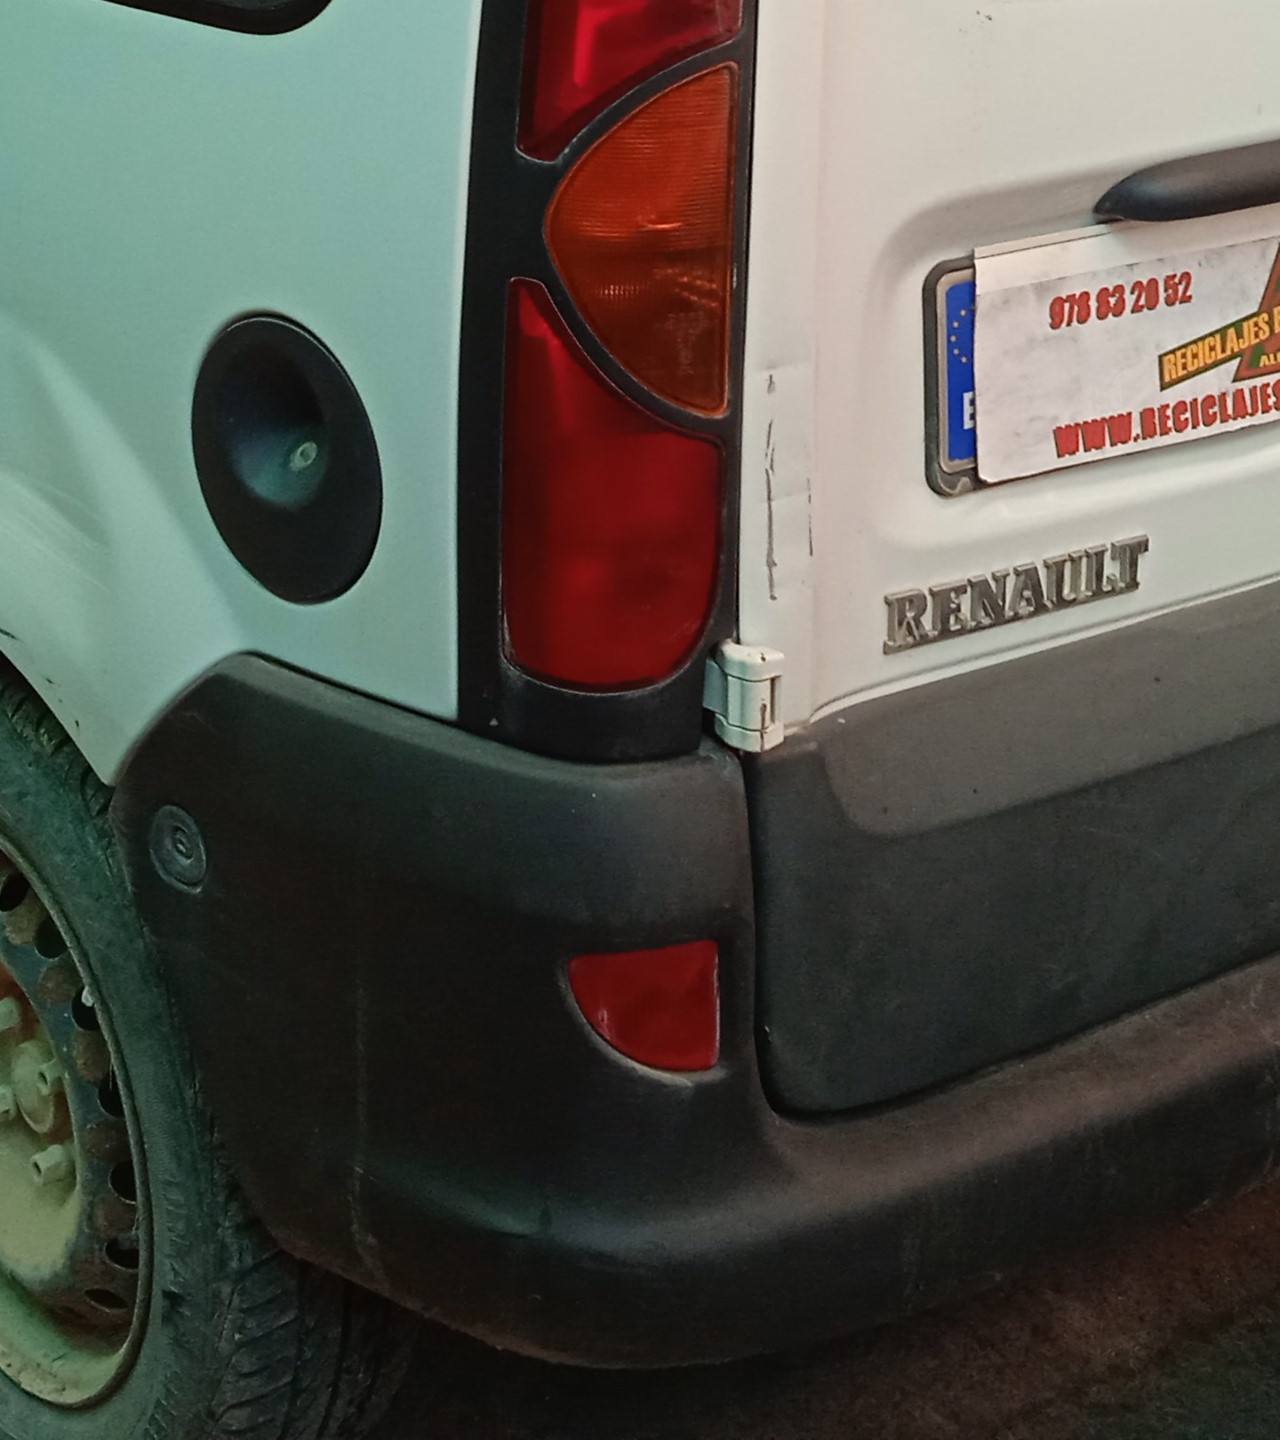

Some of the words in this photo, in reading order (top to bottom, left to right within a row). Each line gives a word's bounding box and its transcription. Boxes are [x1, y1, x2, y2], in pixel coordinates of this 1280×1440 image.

[1049, 290, 1091, 330] 978
[1095, 283, 1126, 320] 83
[1130, 277, 1160, 314] 20
[1164, 270, 1193, 306] 52
[1163, 311, 1270, 383] RECICLAJES
[882, 534, 1150, 656] RENAULT
